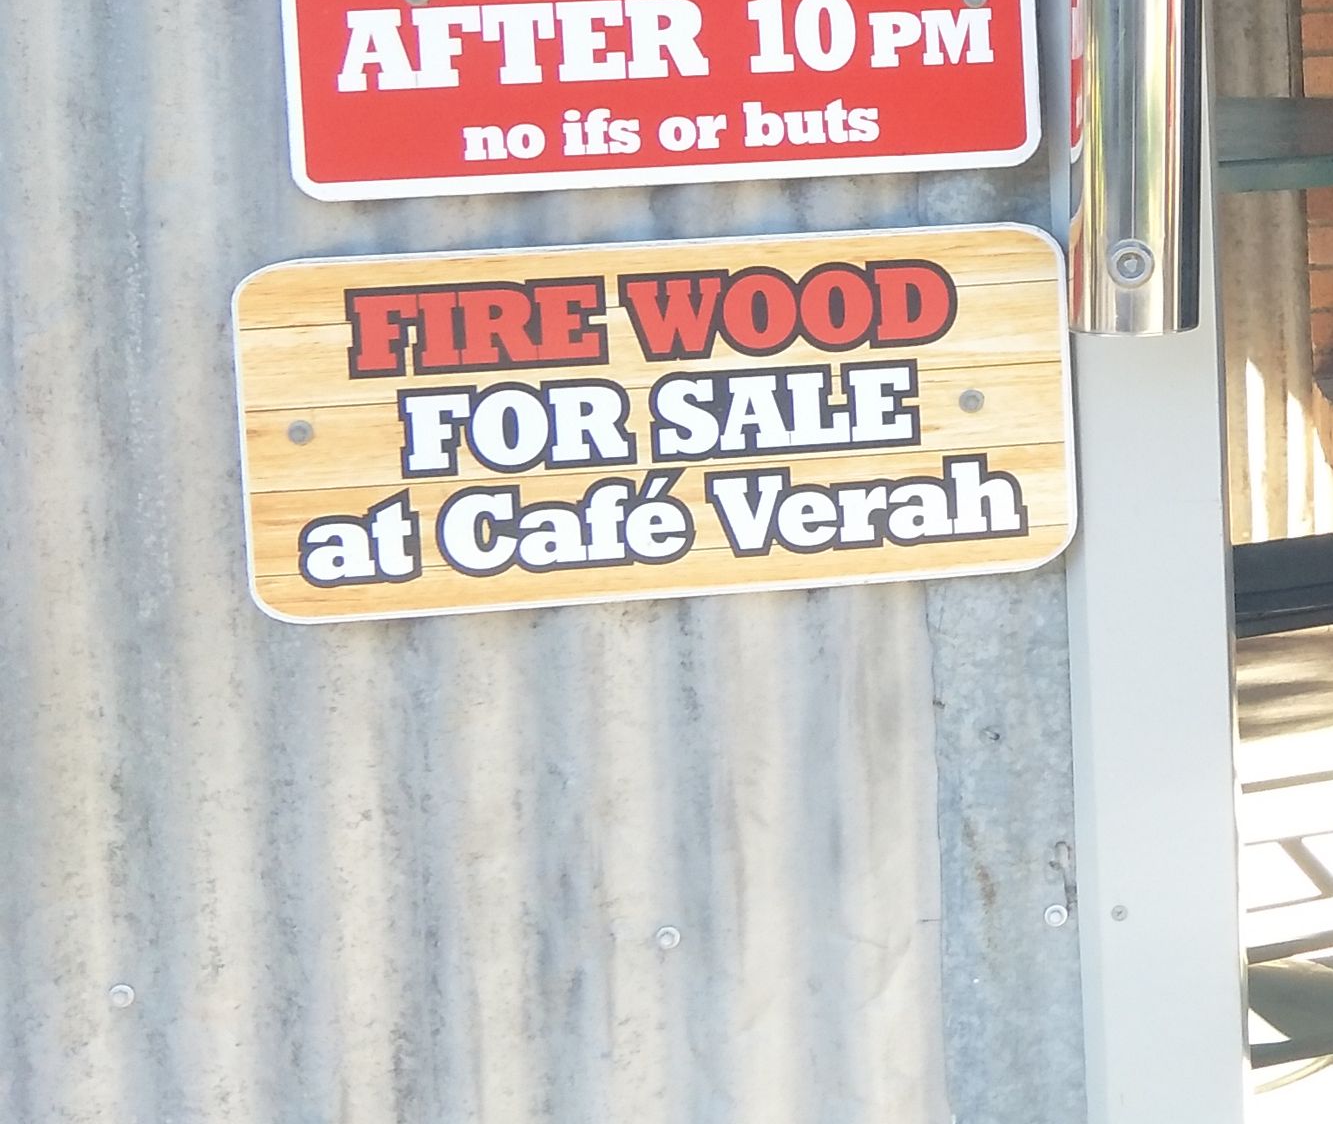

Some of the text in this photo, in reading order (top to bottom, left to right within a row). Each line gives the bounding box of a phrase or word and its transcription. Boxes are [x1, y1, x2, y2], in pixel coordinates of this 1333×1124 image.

[463, 98, 880, 161] no ifs or buts
[344, 259, 958, 378] FIRE WOOD
[397, 359, 920, 476] FOR SALE
[300, 453, 1029, 587] at Café Verah
